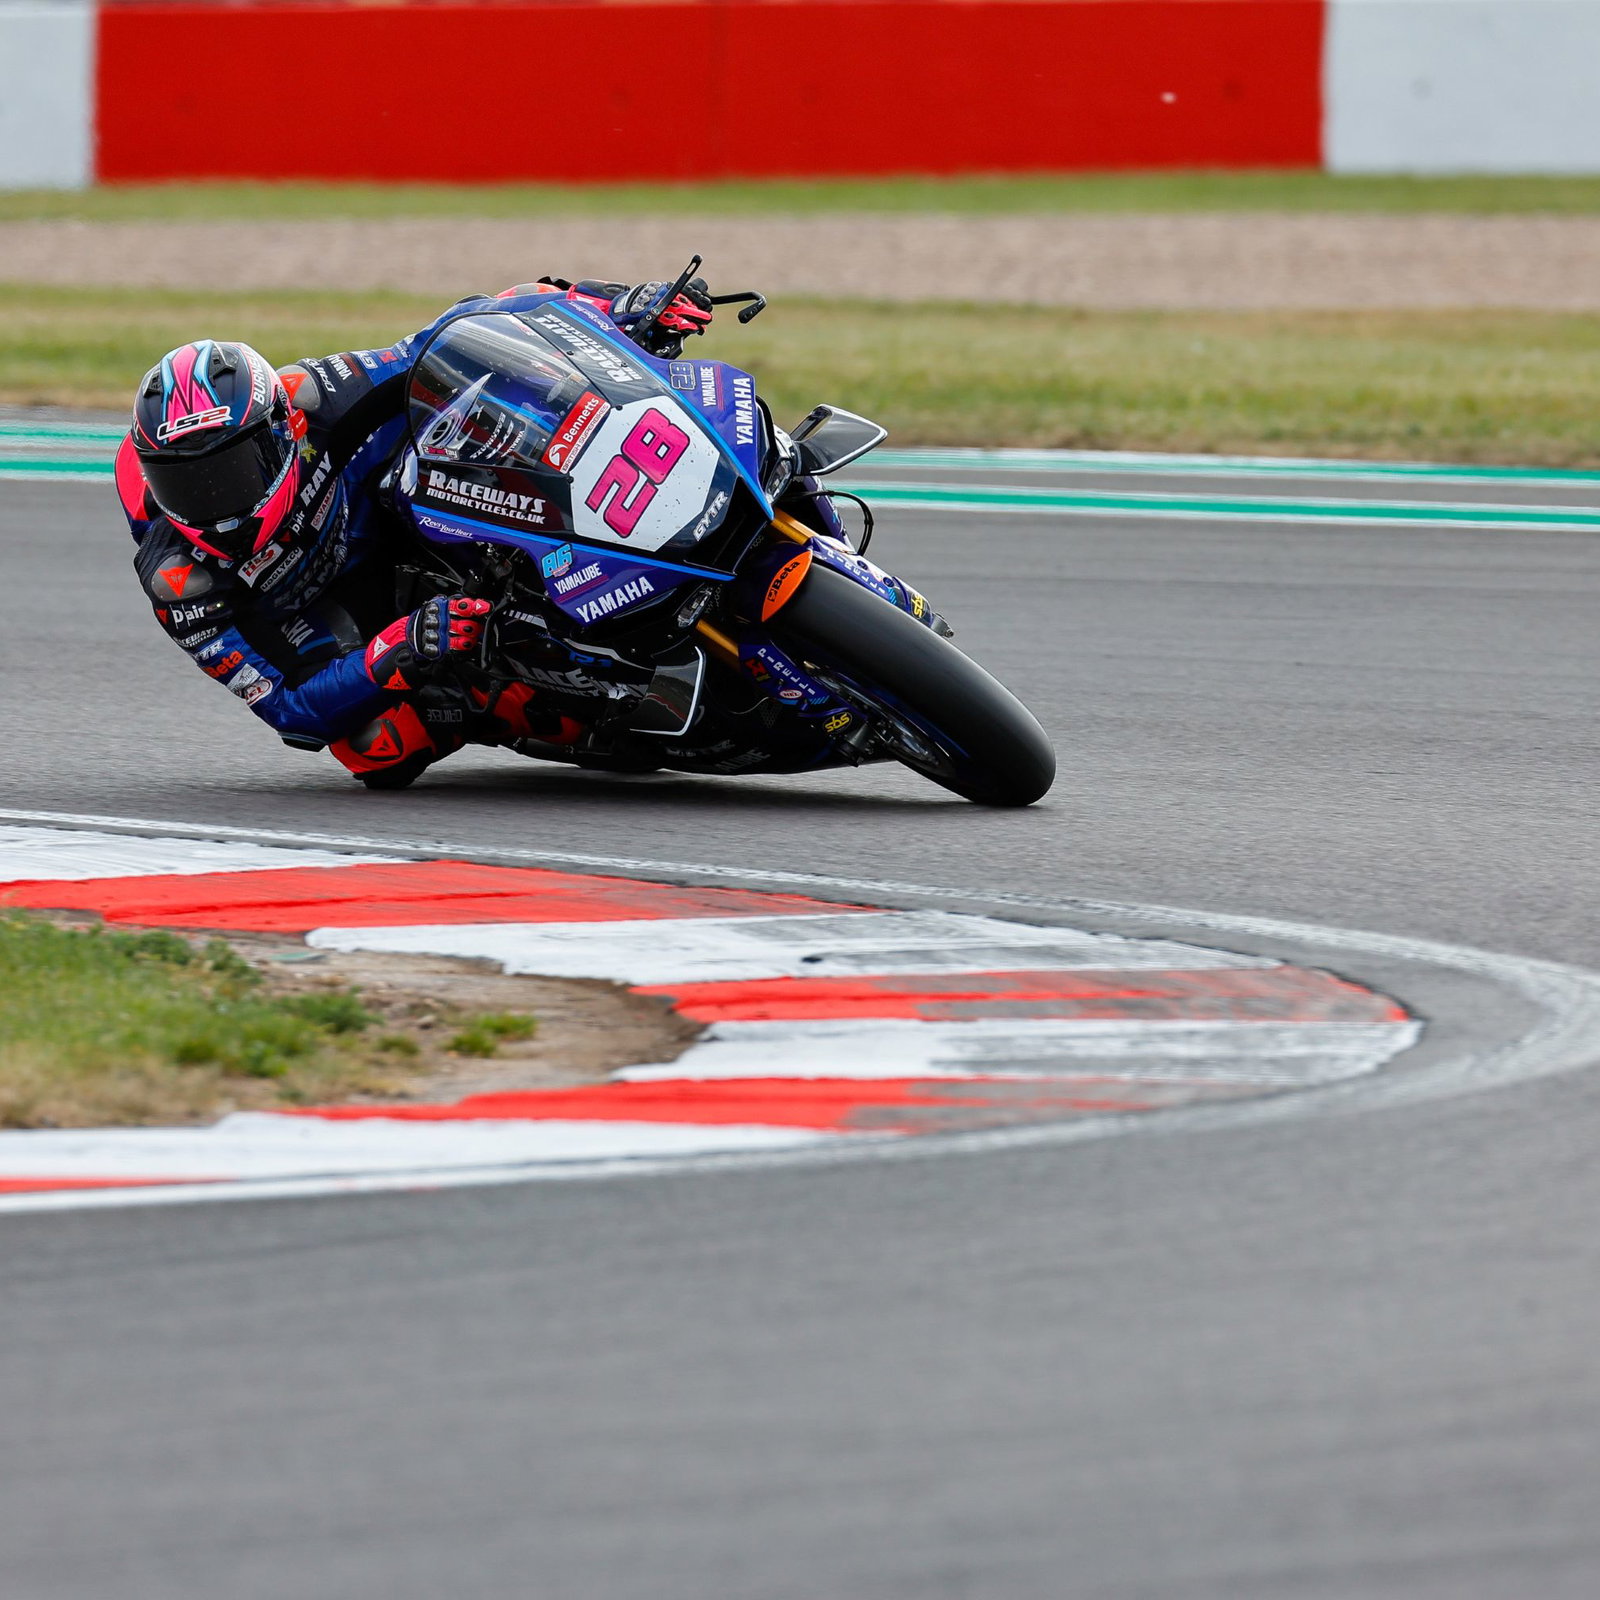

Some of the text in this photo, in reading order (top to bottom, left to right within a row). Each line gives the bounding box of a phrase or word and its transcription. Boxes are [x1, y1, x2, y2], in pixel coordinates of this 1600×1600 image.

[531, 316, 634, 383] RACEWAYS
[700, 366, 716, 407] YAMALUBE
[157, 405, 233, 441] LS2
[562, 397, 600, 443] Bennetts
[733, 377, 754, 446] YAMAHA
[560, 403, 610, 472] BRITISH SUPERBIKES
[300, 451, 333, 507] RAY
[428, 469, 546, 514] RACEWAYS
[584, 407, 691, 539] 28
[426, 487, 546, 525] MOTORCYCLES.CO.UK
[692, 490, 729, 542] GYTR
[541, 543, 573, 579] 86
[554, 562, 602, 595] YAMALUBE
[771, 560, 800, 590] Beta
[826, 549, 886, 595] PIRELLI
[575, 575, 655, 623] YAMAHA
[757, 647, 816, 696] PIRELLI
[824, 712, 850, 733] sbs
